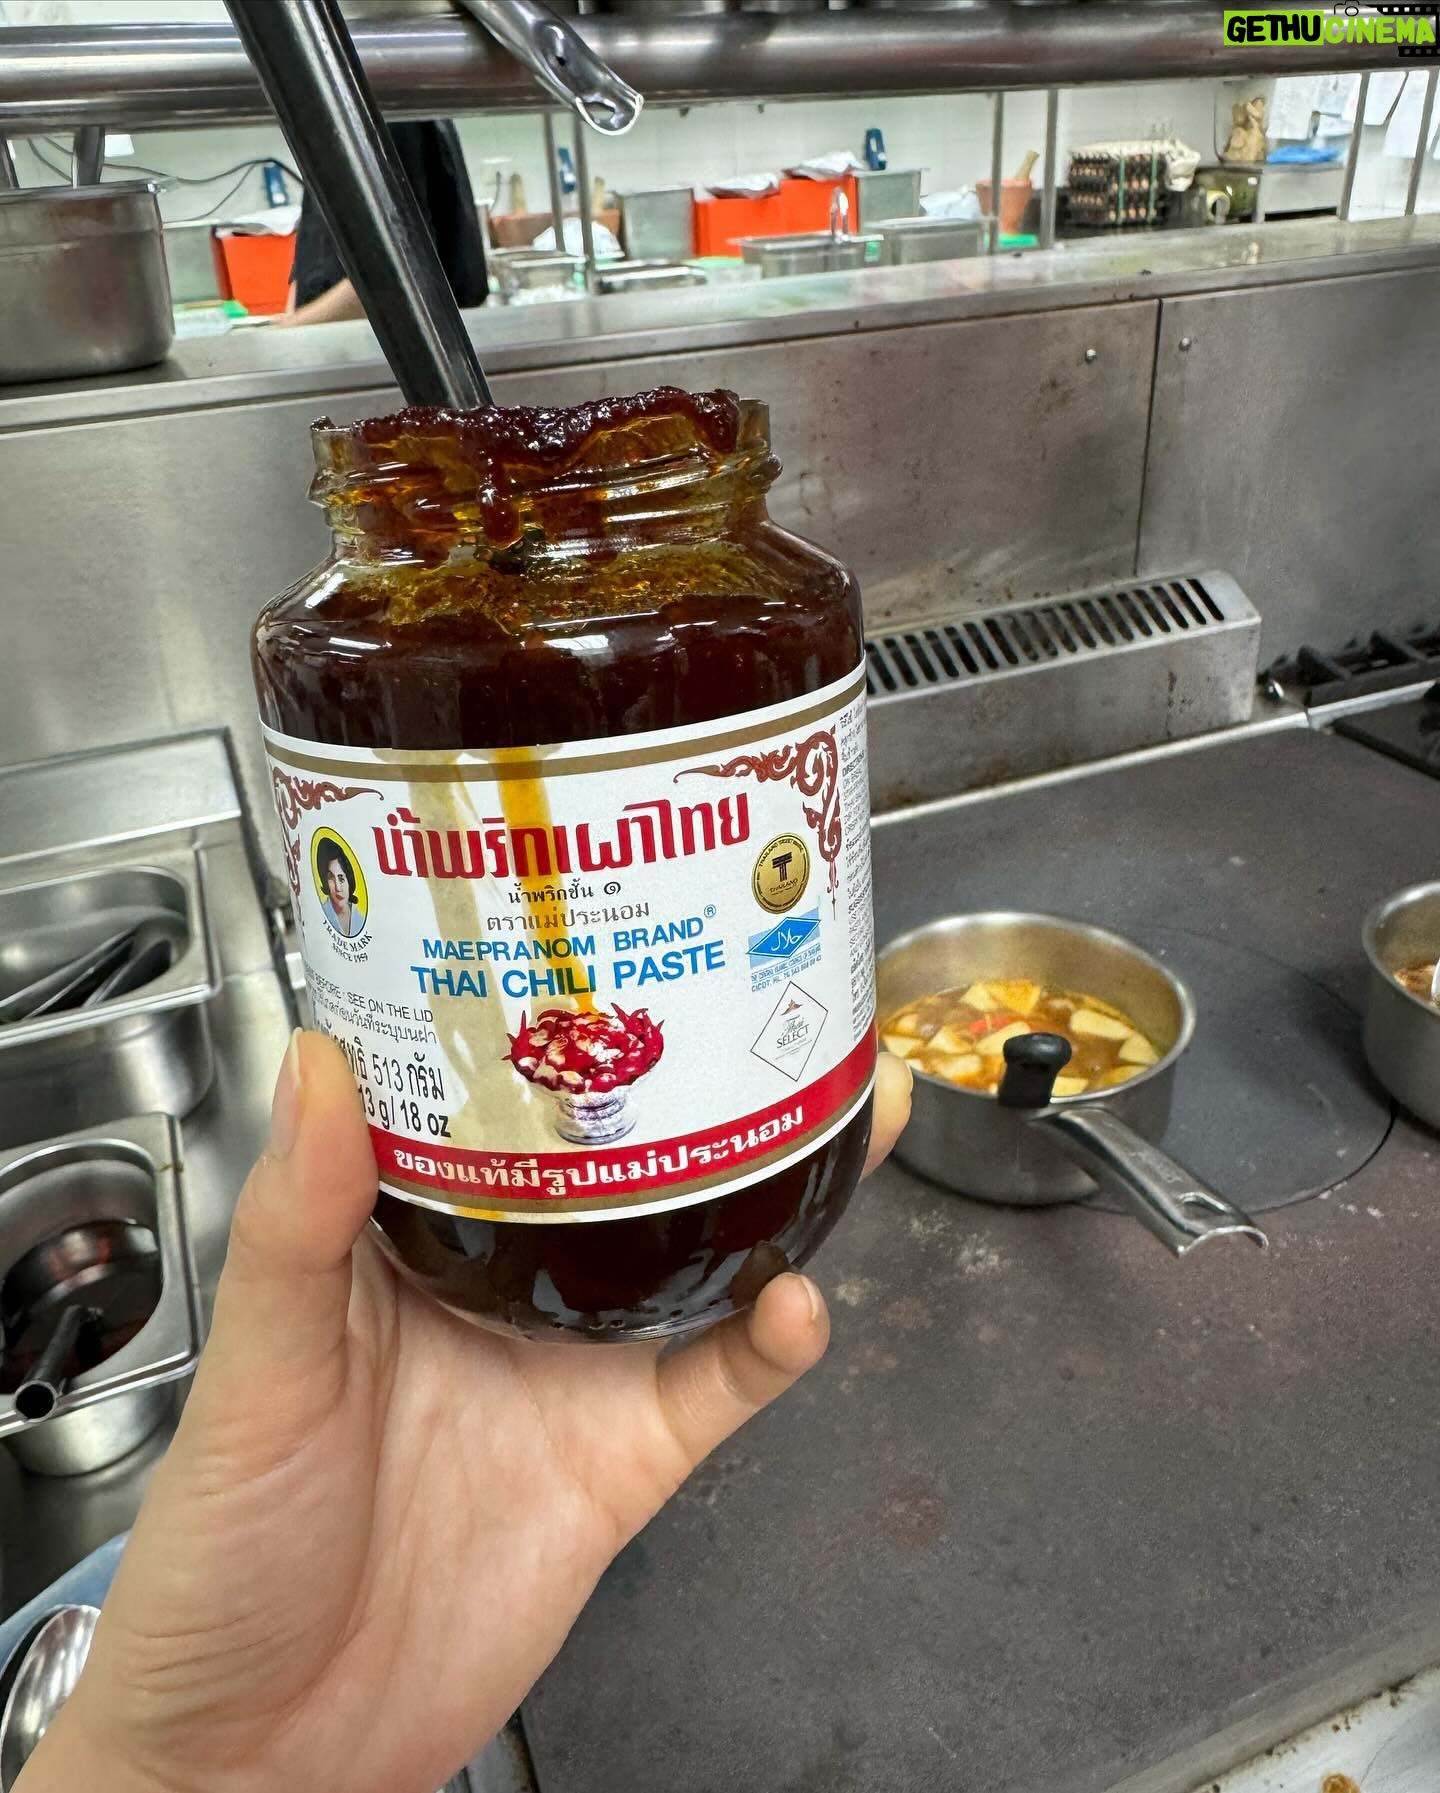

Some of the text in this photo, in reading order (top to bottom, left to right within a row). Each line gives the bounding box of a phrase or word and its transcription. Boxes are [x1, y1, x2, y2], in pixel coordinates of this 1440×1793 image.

[371, 792, 751, 879] น้ำพริกเผาไทย
[508, 878, 622, 904] น้ำพริกชั้น ๑
[487, 901, 650, 931] ตราแม่ประนอม
[410, 939, 726, 998] THAI CHILI PASTE
[423, 935, 596, 961] MAEPRANOM
[347, 991, 367, 1009] SEE
[368, 998, 384, 1014] ON
[386, 1003, 411, 1020] THE
[413, 1008, 434, 1023] LID
[776, 1024, 810, 1049] SELECT
[372, 1051, 445, 1101] 513 กรัม
[358, 1084, 376, 1117] 13
[400, 1099, 421, 1132] 18
[427, 1112, 452, 1138] oz
[393, 1104, 804, 1196] ของแท้มีรูปแม่ประนอม
